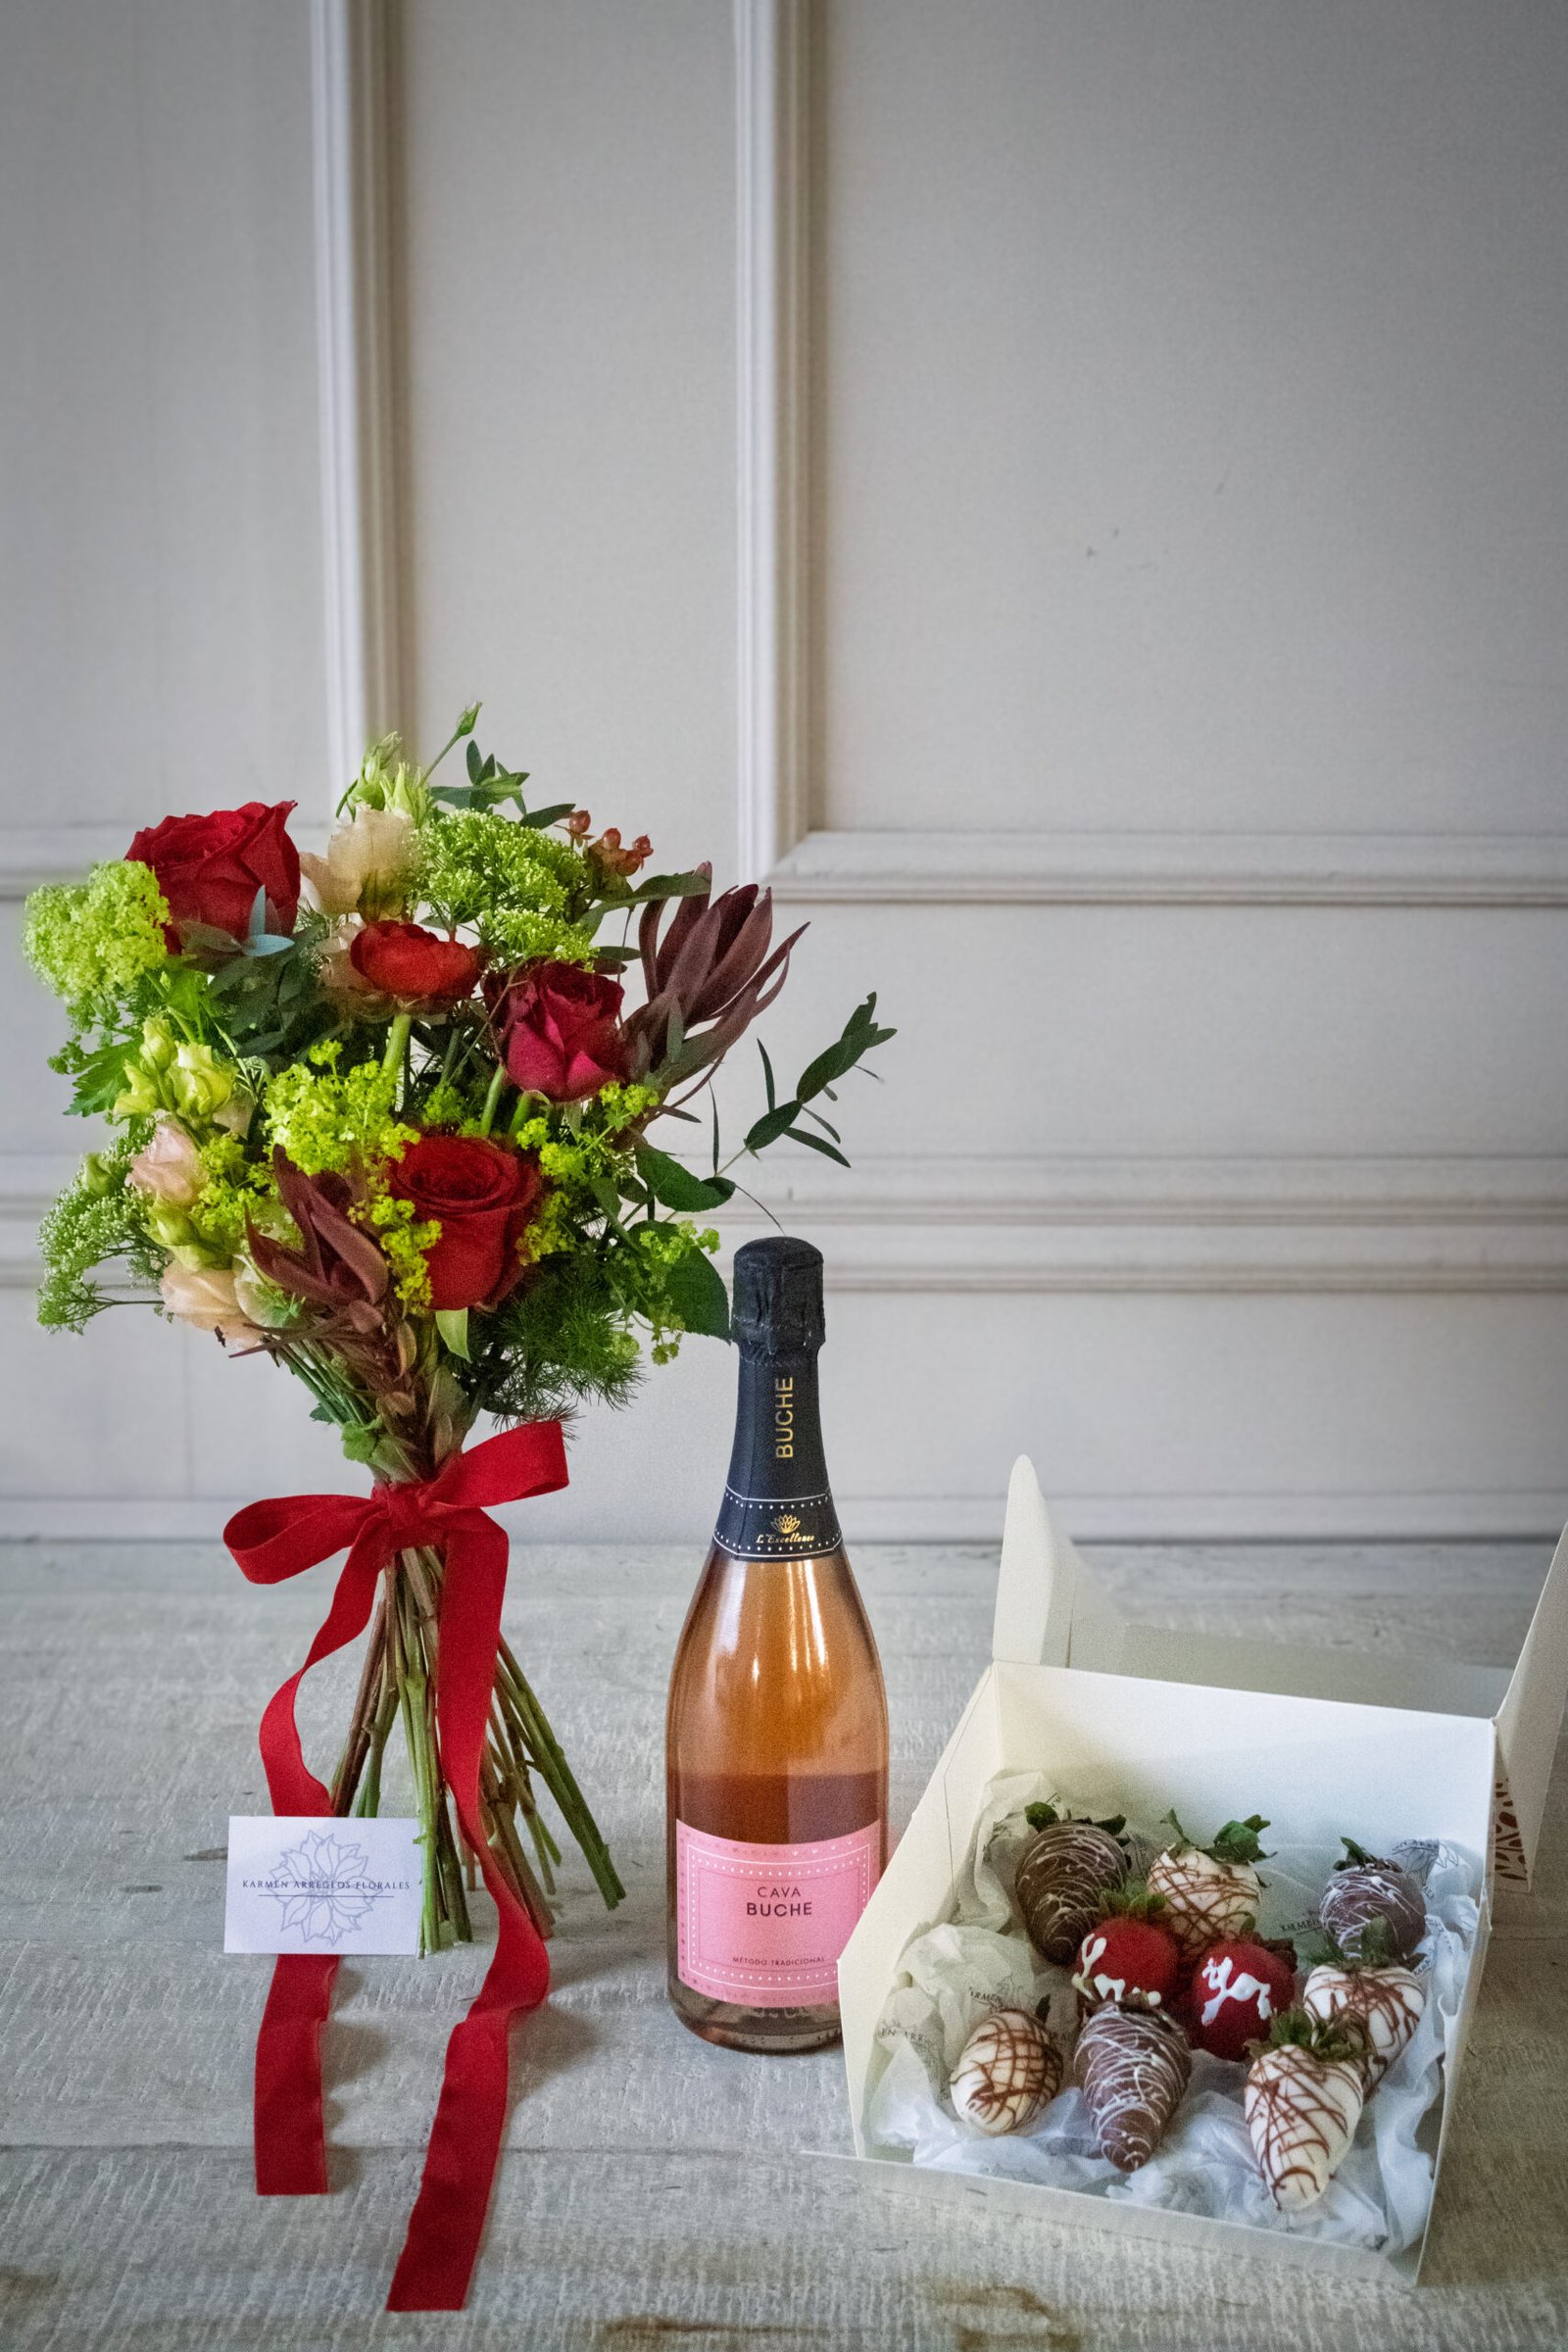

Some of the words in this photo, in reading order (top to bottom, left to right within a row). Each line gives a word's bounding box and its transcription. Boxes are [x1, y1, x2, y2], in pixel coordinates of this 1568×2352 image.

[775, 1376, 794, 1459] BUCHE
[242, 1880, 289, 1888] KARMEN
[293, 1880, 351, 1889] ARREGLOS
[355, 1881, 411, 1889] FLORALES
[757, 1886, 801, 1898] CAVA
[746, 1901, 812, 1917] BUCHE
